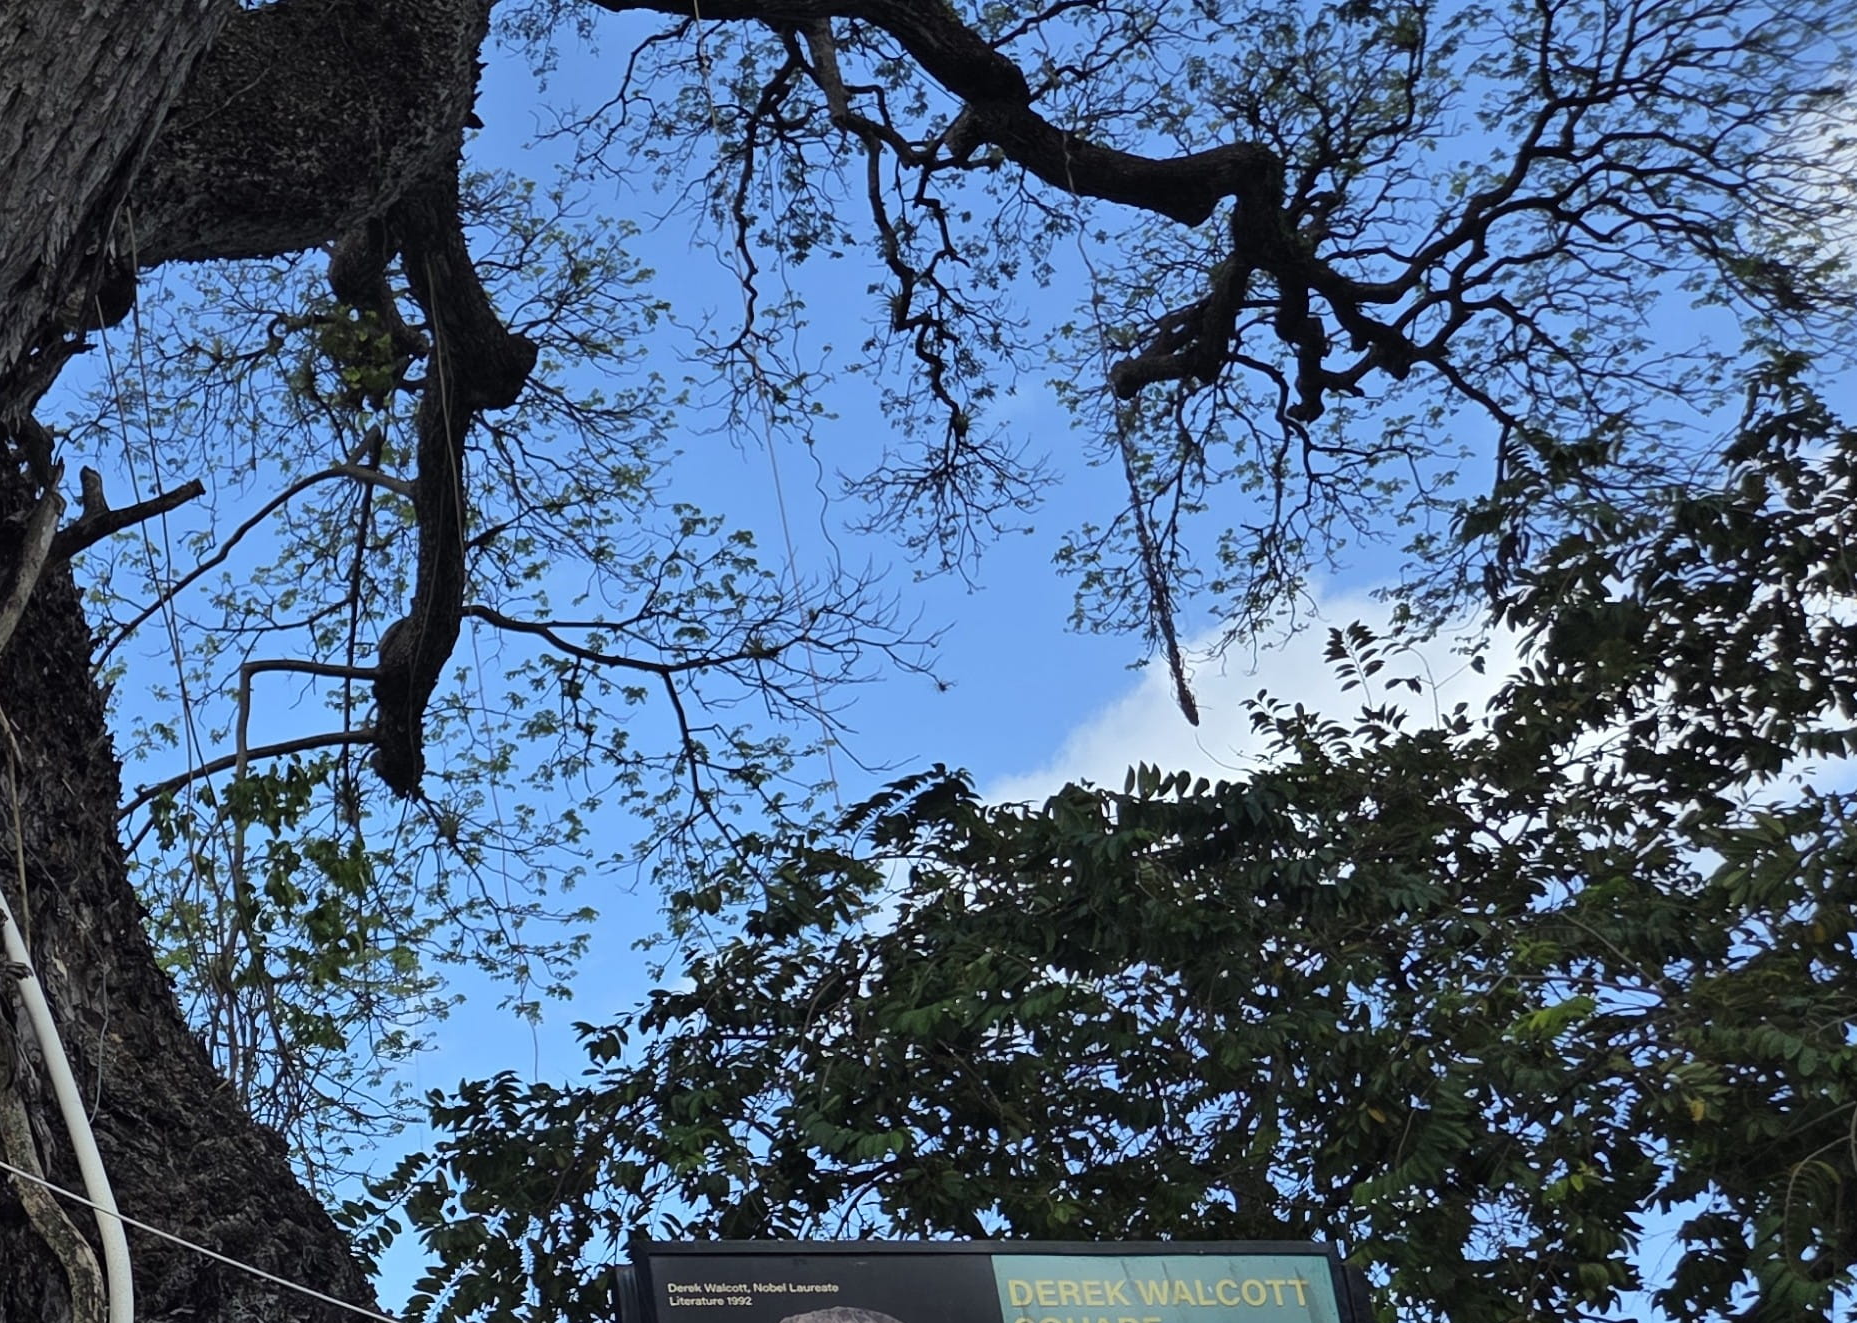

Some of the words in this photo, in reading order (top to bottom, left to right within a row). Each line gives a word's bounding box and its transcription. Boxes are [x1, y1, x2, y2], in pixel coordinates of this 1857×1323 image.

[667, 1283, 702, 1293] Derek
[704, 1283, 751, 1295] Walcott,
[753, 1283, 787, 1293] Nobel
[788, 1283, 839, 1293] Laureate
[1007, 1279, 1130, 1307] DEREK
[1135, 1279, 1308, 1307] WALCOTT
[669, 1296, 725, 1306] Literature
[727, 1296, 753, 1306] 1992
